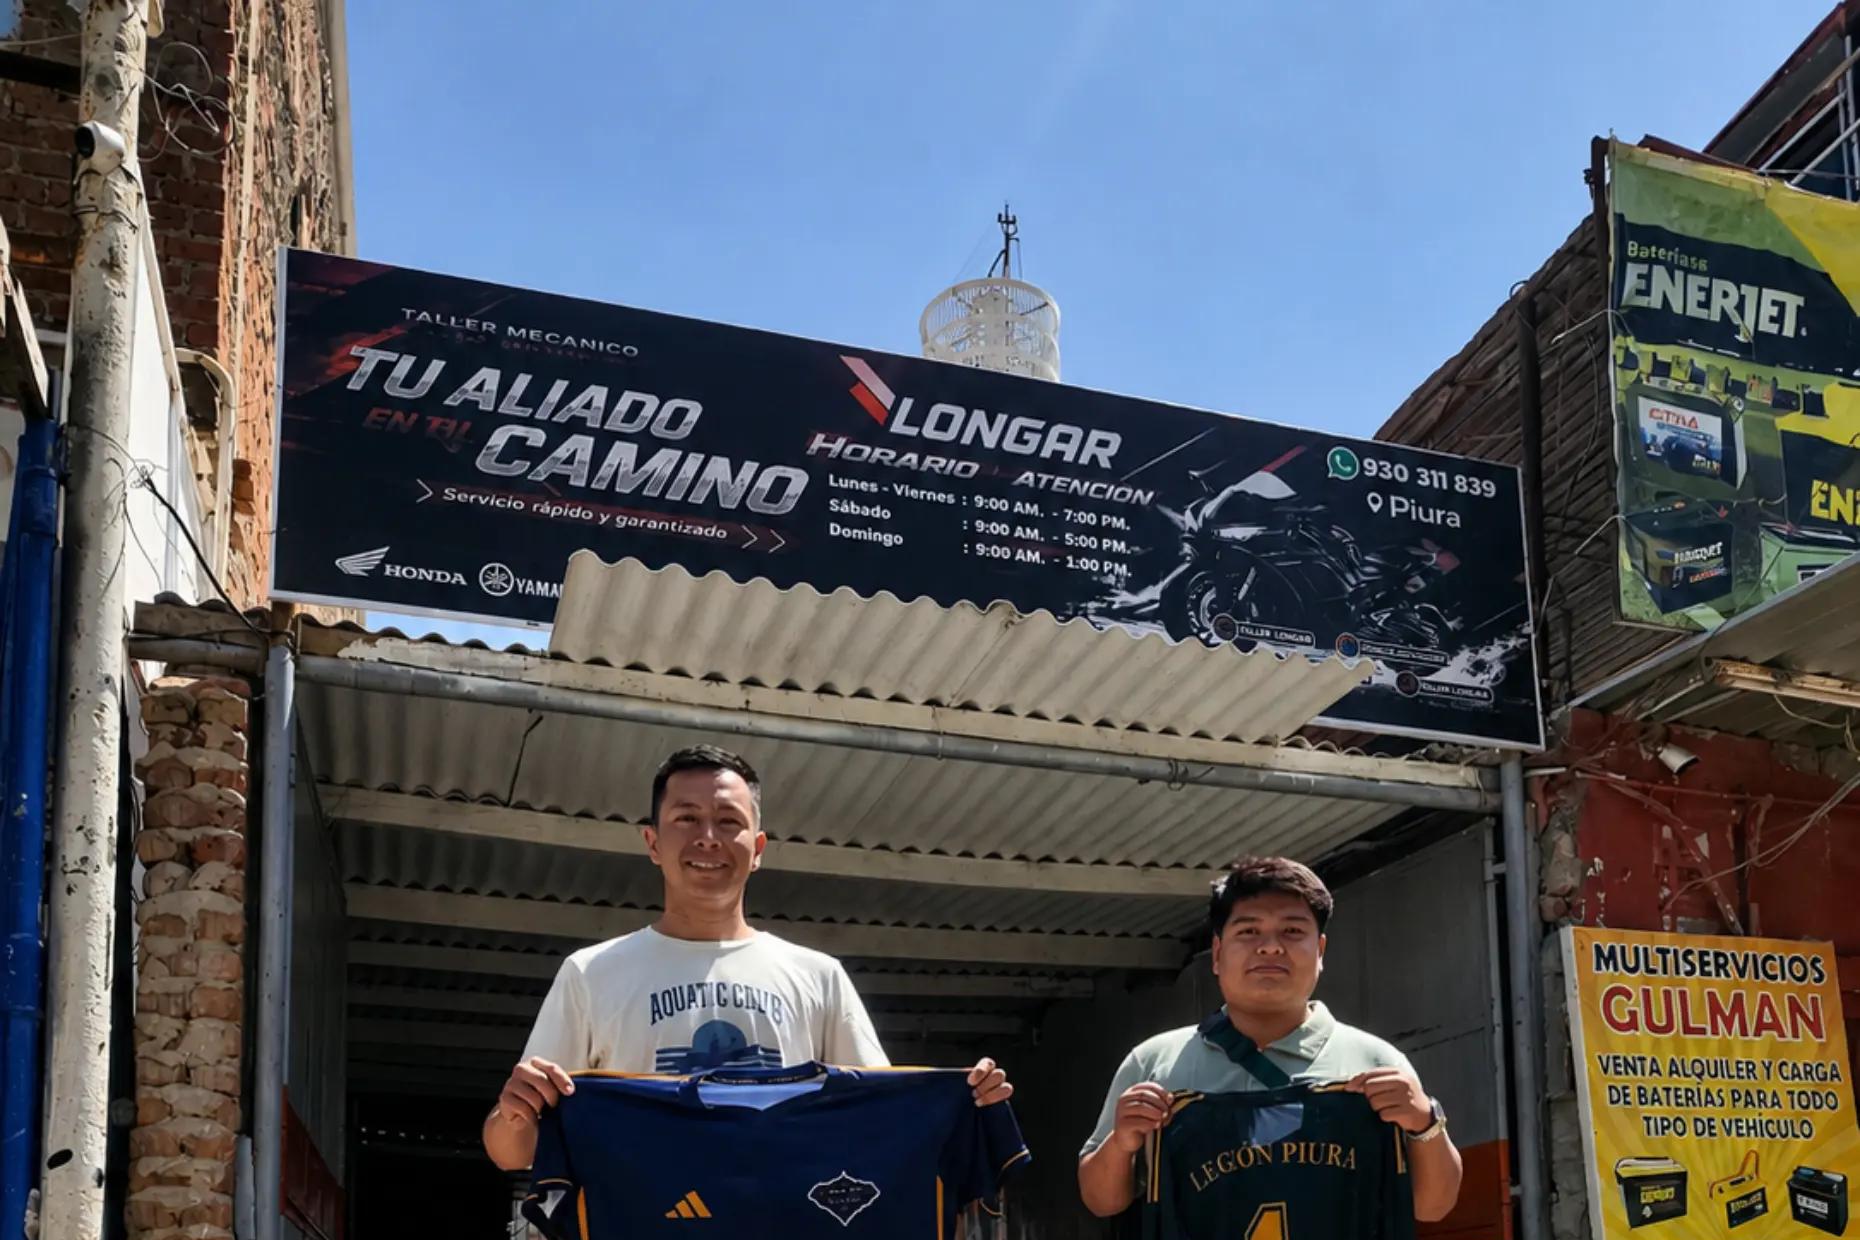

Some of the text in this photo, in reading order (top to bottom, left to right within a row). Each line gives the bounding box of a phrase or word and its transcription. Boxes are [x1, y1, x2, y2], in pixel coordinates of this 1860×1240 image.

[401, 308, 497, 334] TALLER
[507, 326, 639, 358] MECANICO
[346, 345, 446, 399] TU
[443, 367, 703, 440] ALIADO
[890, 397, 1122, 469] LONGAR
[475, 425, 810, 515] CAMINO
[806, 433, 1154, 505] HORARIO ATENCION
[1363, 458, 1496, 498] 930 311 839
[443, 487, 728, 540] Servicio rápido y garantizado
[829, 473, 878, 493] Lunes
[893, 482, 955, 505] Viernes
[974, 495, 1009, 512] 9:00
[1014, 502, 1045, 517] AM.
[1063, 509, 1097, 526] 7:00
[1102, 515, 1131, 531] PM.
[829, 498, 892, 520] Sábado
[975, 519, 1010, 536] 9:00
[1014, 527, 1045, 541] AM.
[1064, 533, 1098, 550] 5:00
[1102, 539, 1131, 554] PM.
[1390, 495, 1461, 528] Piura
[384, 564, 468, 586] HONDA
[829, 523, 904, 547] Domingo
[976, 543, 1011, 559] 9:00
[1015, 550, 1046, 564] AM.
[1066, 556, 1099, 572] 1:00
[1103, 561, 1132, 577] PM.
[514, 577, 563, 598] YAMA
[1593, 943, 1826, 984] MULTISERVICIOS
[1602, 986, 1826, 1040] GULMAN
[1598, 1055, 1842, 1083] VENTA ALQUILER Y CARGA
[1608, 1082, 1839, 1111] DE BATERÍAS PARA TODO
[1643, 1112, 1813, 1139] TIPO DE VEHÍCULO
[1189, 1140, 1357, 1192] LEGÓN PIURA
